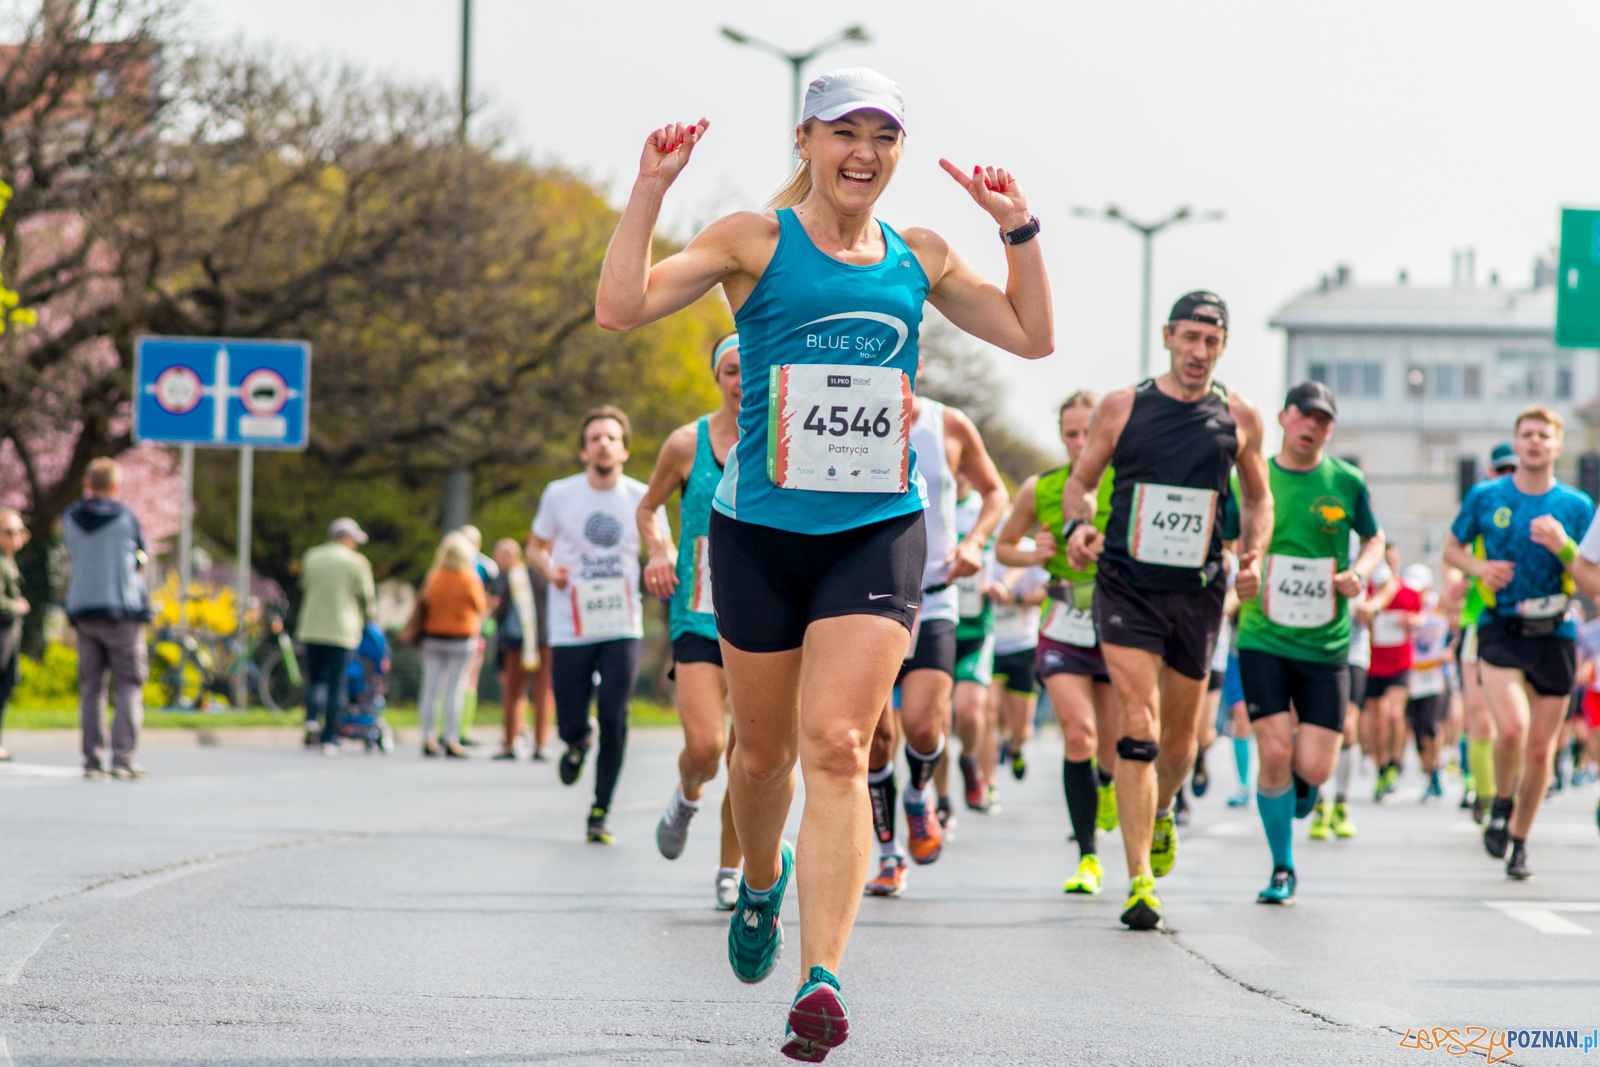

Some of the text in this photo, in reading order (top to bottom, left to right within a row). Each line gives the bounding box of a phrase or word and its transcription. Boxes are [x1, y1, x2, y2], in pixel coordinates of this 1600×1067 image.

[806, 333, 886, 351] BLUE SKY
[803, 405, 891, 438] 4546
[828, 444, 869, 456] Patrycja
[1152, 510, 1203, 534] 4973
[1278, 578, 1327, 599] 4245
